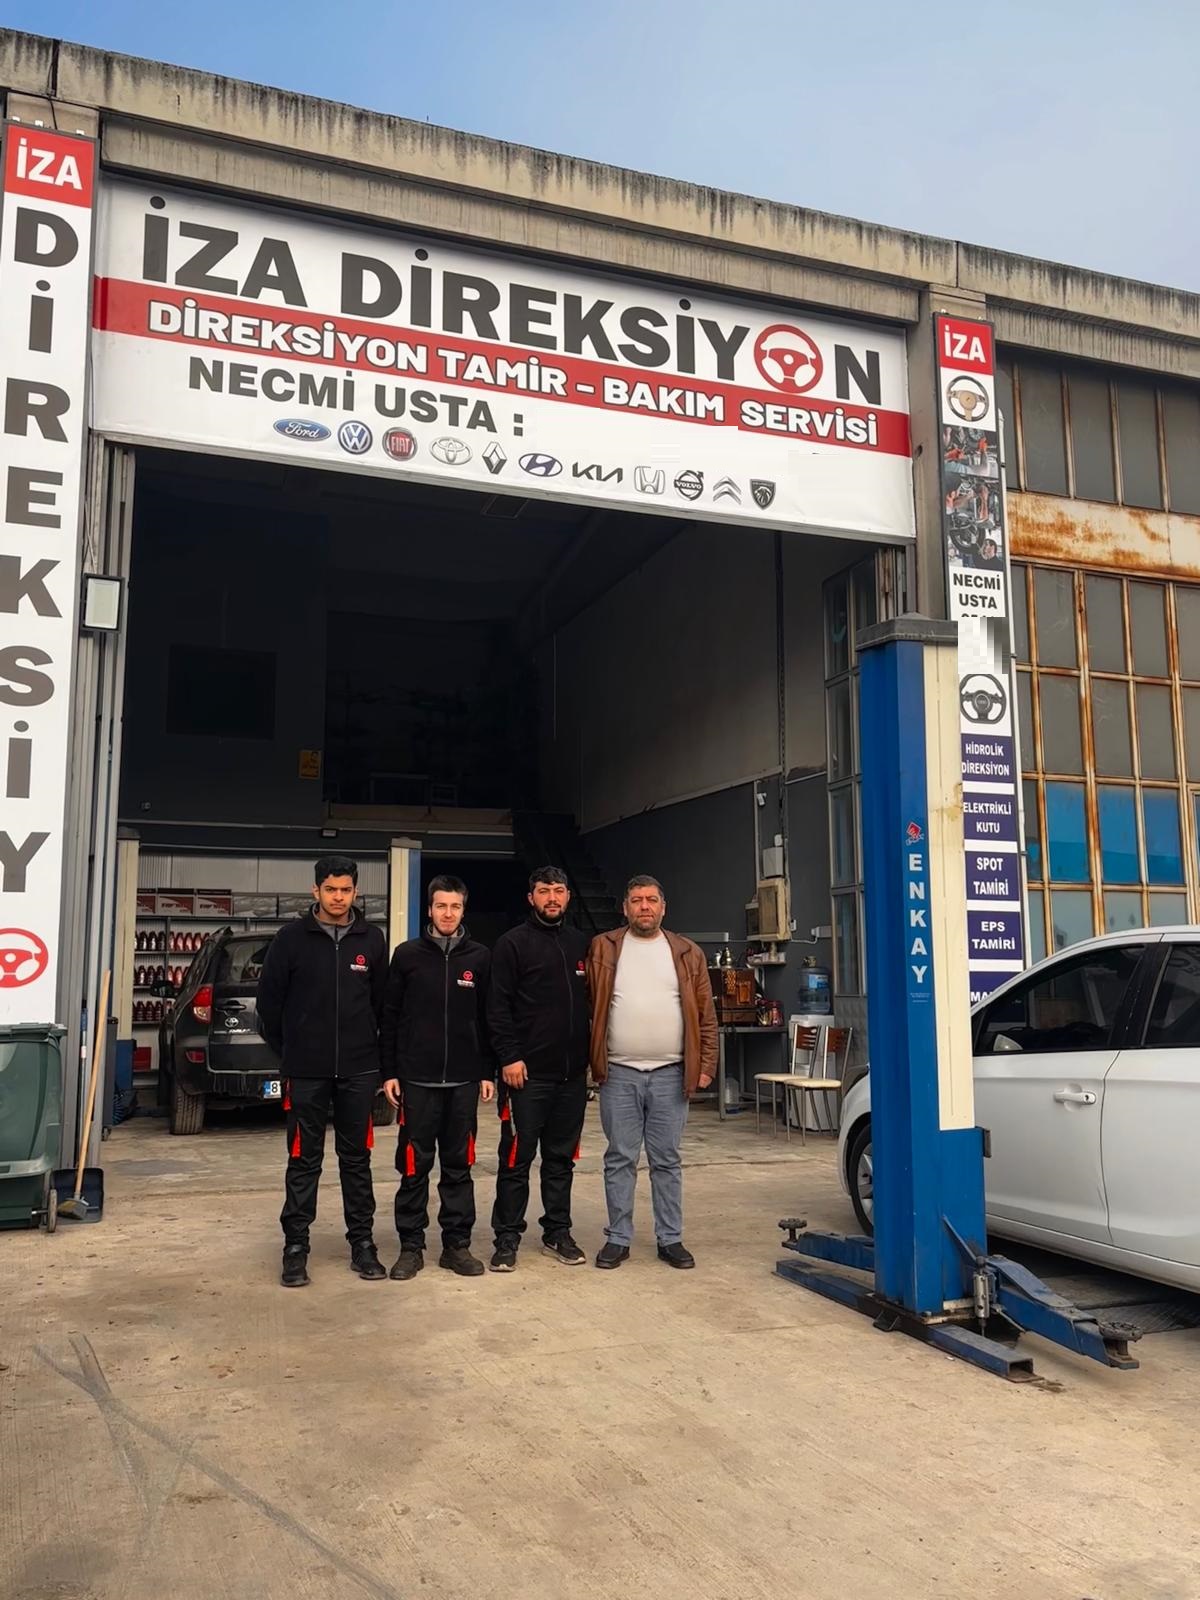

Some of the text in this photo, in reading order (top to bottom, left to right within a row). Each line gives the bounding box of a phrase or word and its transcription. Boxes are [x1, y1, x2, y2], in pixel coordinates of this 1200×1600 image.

[16, 138, 83, 191] İZA
[141, 196, 308, 308] İZA
[944, 325, 986, 363] İZA
[149, 298, 427, 374] DİREKSİYON
[437, 347, 568, 397] TAMİR
[603, 376, 725, 423] BAKIM
[740, 400, 879, 447] SERVİSİ
[188, 356, 356, 412] NECMİ
[374, 384, 499, 434] USTA
[284, 421, 320, 439] Ford
[953, 573, 1001, 591] NECMİ
[959, 593, 998, 610] USTA
[965, 741, 1004, 756] HİDROLİK
[961, 760, 1010, 777] DİREKSİYON
[963, 801, 1012, 816] ELEKTRİKLİ
[976, 821, 1000, 834] KUTU
[976, 856, 1004, 872] SPOT
[973, 878, 1009, 896] TAMİRİ
[908, 853, 928, 983] ENKAY
[981, 921, 1005, 932] EPS
[972, 937, 1016, 950] TAMİRİ
